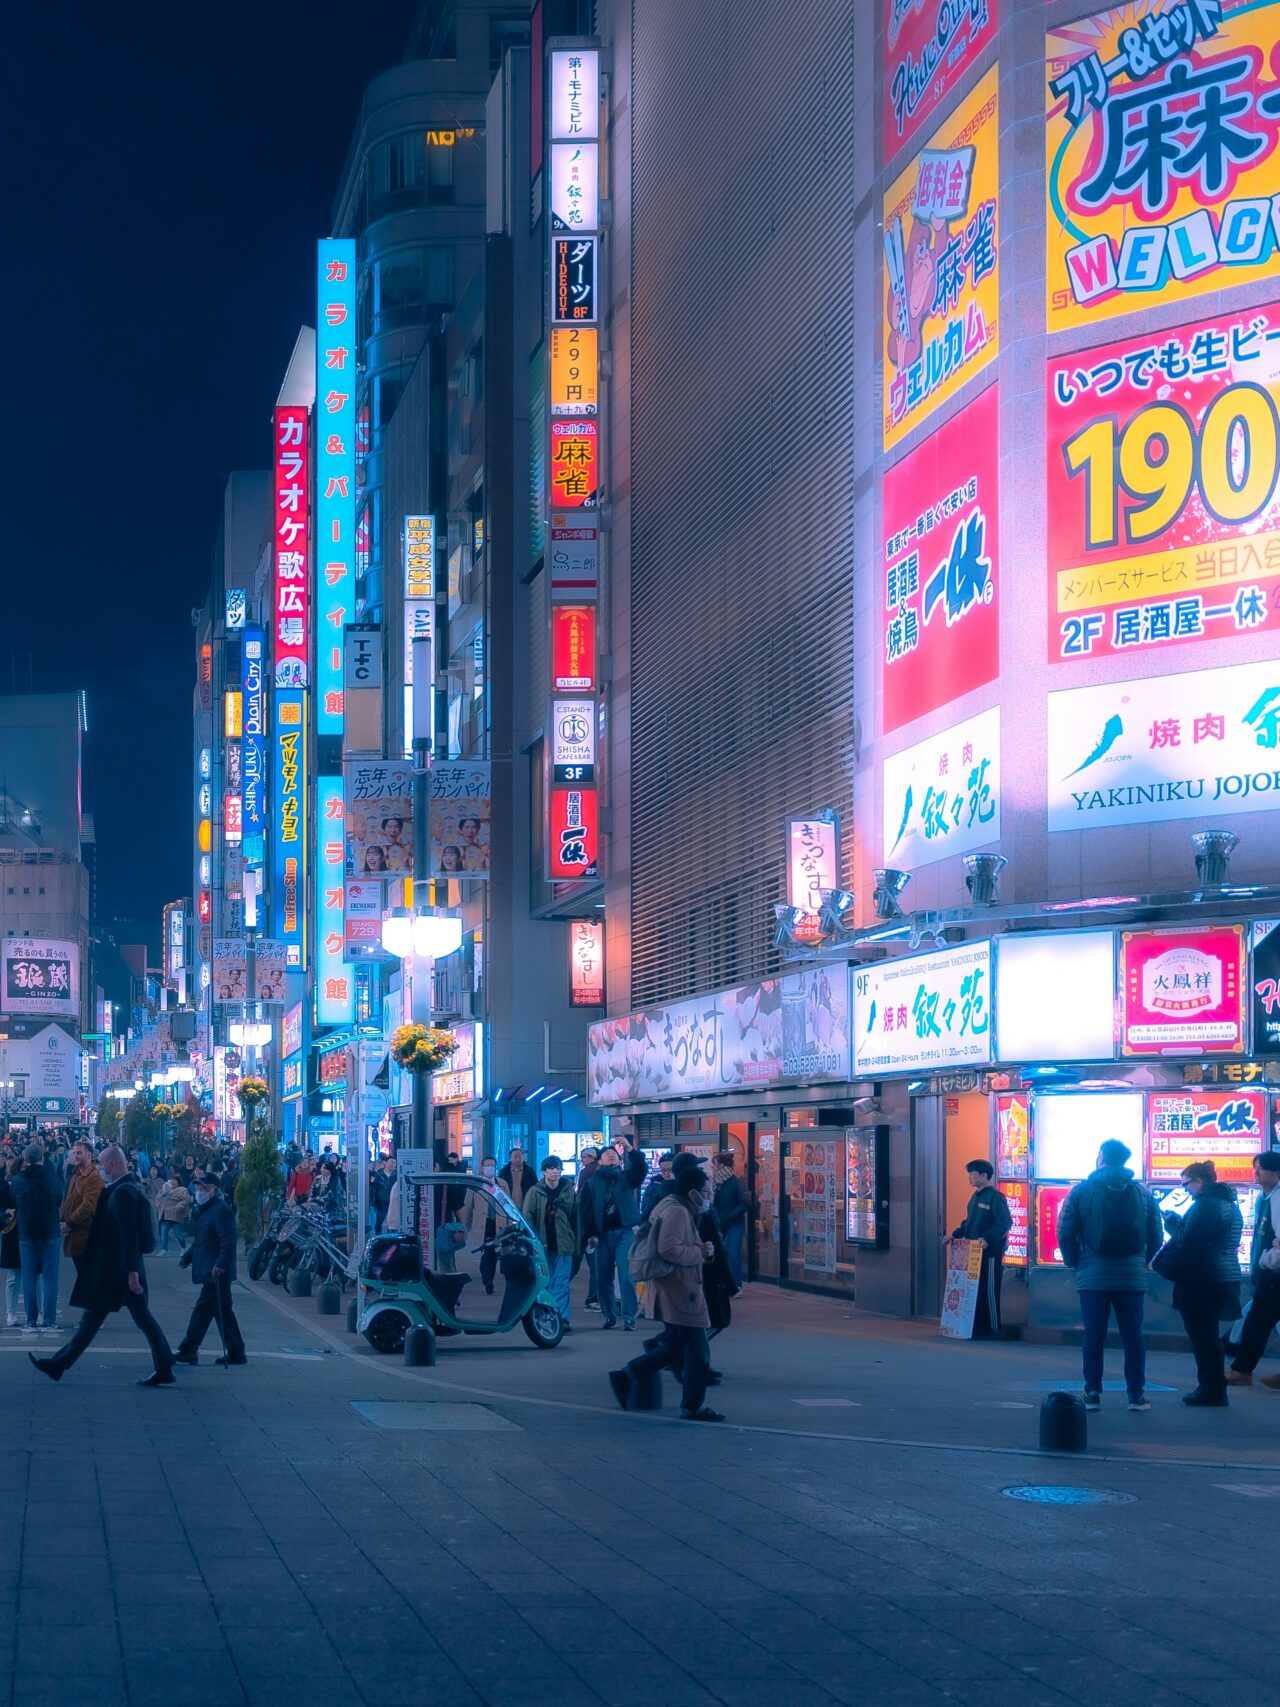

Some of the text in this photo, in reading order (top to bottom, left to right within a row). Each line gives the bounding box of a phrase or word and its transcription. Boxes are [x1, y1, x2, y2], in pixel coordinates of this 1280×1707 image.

[568, 57, 583, 134] 第1モナミビル
[918, 158, 964, 209] 低料金
[553, 221, 564, 230] 9F
[570, 241, 593, 304] ダーツ
[933, 205, 996, 316] 麻雀
[558, 242, 568, 319] HIDEOUT
[573, 306, 588, 318] 8F
[888, 300, 988, 421] ウェルカム
[553, 422, 596, 435] ウェルカム
[553, 436, 594, 498] 麻雀
[278, 415, 306, 647] カラオケ歌広場
[886, 551, 920, 610] 居酒屋
[886, 609, 920, 664] 焼鳥
[1062, 587, 1266, 654] 2F 居酒屋一休
[1148, 712, 1226, 751] 焼肉
[557, 745, 591, 754] SHISHA
[938, 740, 974, 778] 焼肉
[354, 767, 388, 785] 忘年
[432, 767, 466, 785] 忘年
[564, 767, 583, 780] 3F
[567, 792, 581, 826] 居酒屋
[1071, 778, 1206, 812] YAKINIKU
[559, 827, 588, 865] 一休
[585, 867, 597, 876] 2F
[324, 797, 349, 1001] カラオケ館
[351, 927, 376, 936] 729
[1254, 922, 1273, 935] 8F
[856, 974, 870, 998] 9F
[1152, 971, 1213, 991] 火鳳祥
[882, 967, 989, 1039] 焼肉 叙々苑
[1152, 1101, 1259, 1135] 居酒屋 一休
[1152, 1141, 1167, 1151] 2F
[1152, 1189, 1166, 1199] 3F
